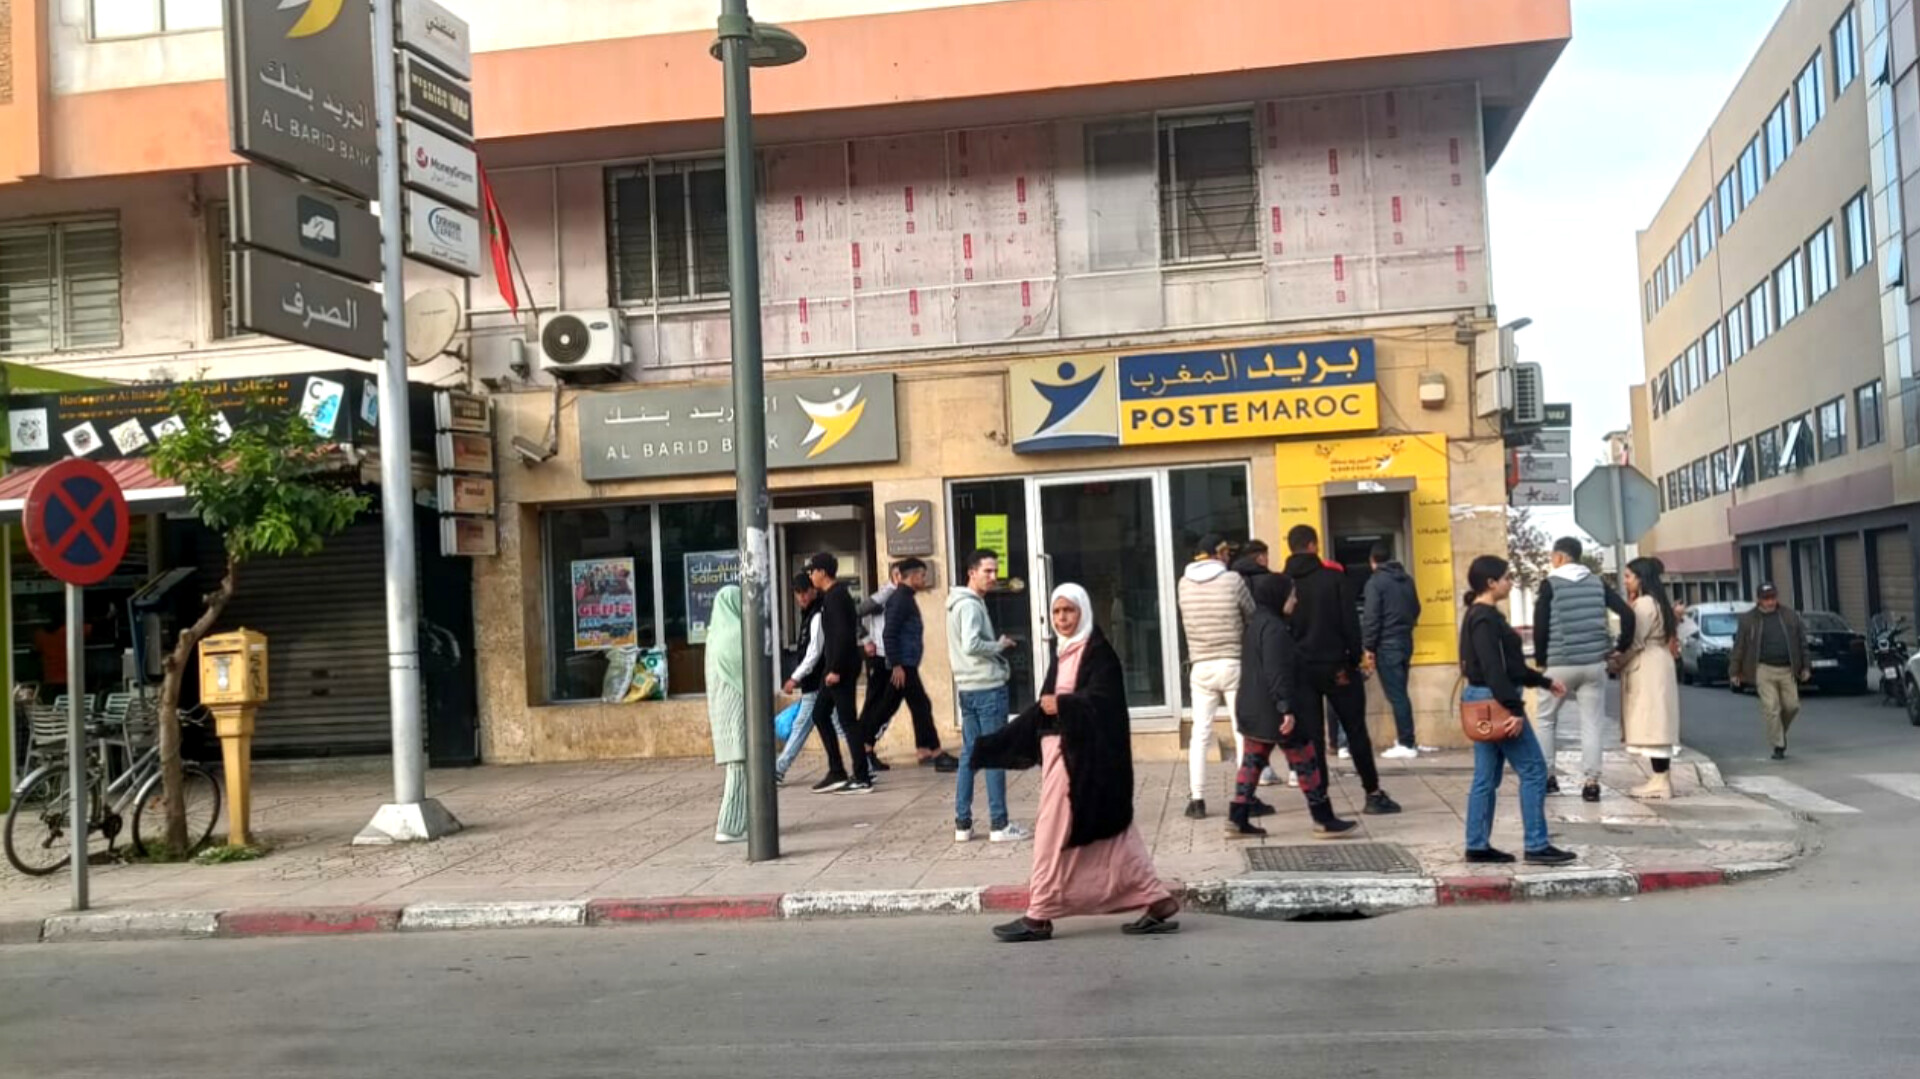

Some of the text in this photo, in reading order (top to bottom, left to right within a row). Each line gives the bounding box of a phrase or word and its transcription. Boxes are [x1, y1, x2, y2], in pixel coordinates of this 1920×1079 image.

[259, 61, 370, 132] البريد بنك
[411, 72, 448, 98] WESTERN
[262, 109, 371, 166] AL BARID BANK
[430, 156, 474, 184] MoneyGram
[282, 281, 358, 331] الصرف
[1130, 347, 1359, 396] بريد المغرب
[604, 396, 777, 427] الريد بنك
[1131, 394, 1361, 430] POSTE MAROC
[606, 433, 779, 460] AL BARID BK
